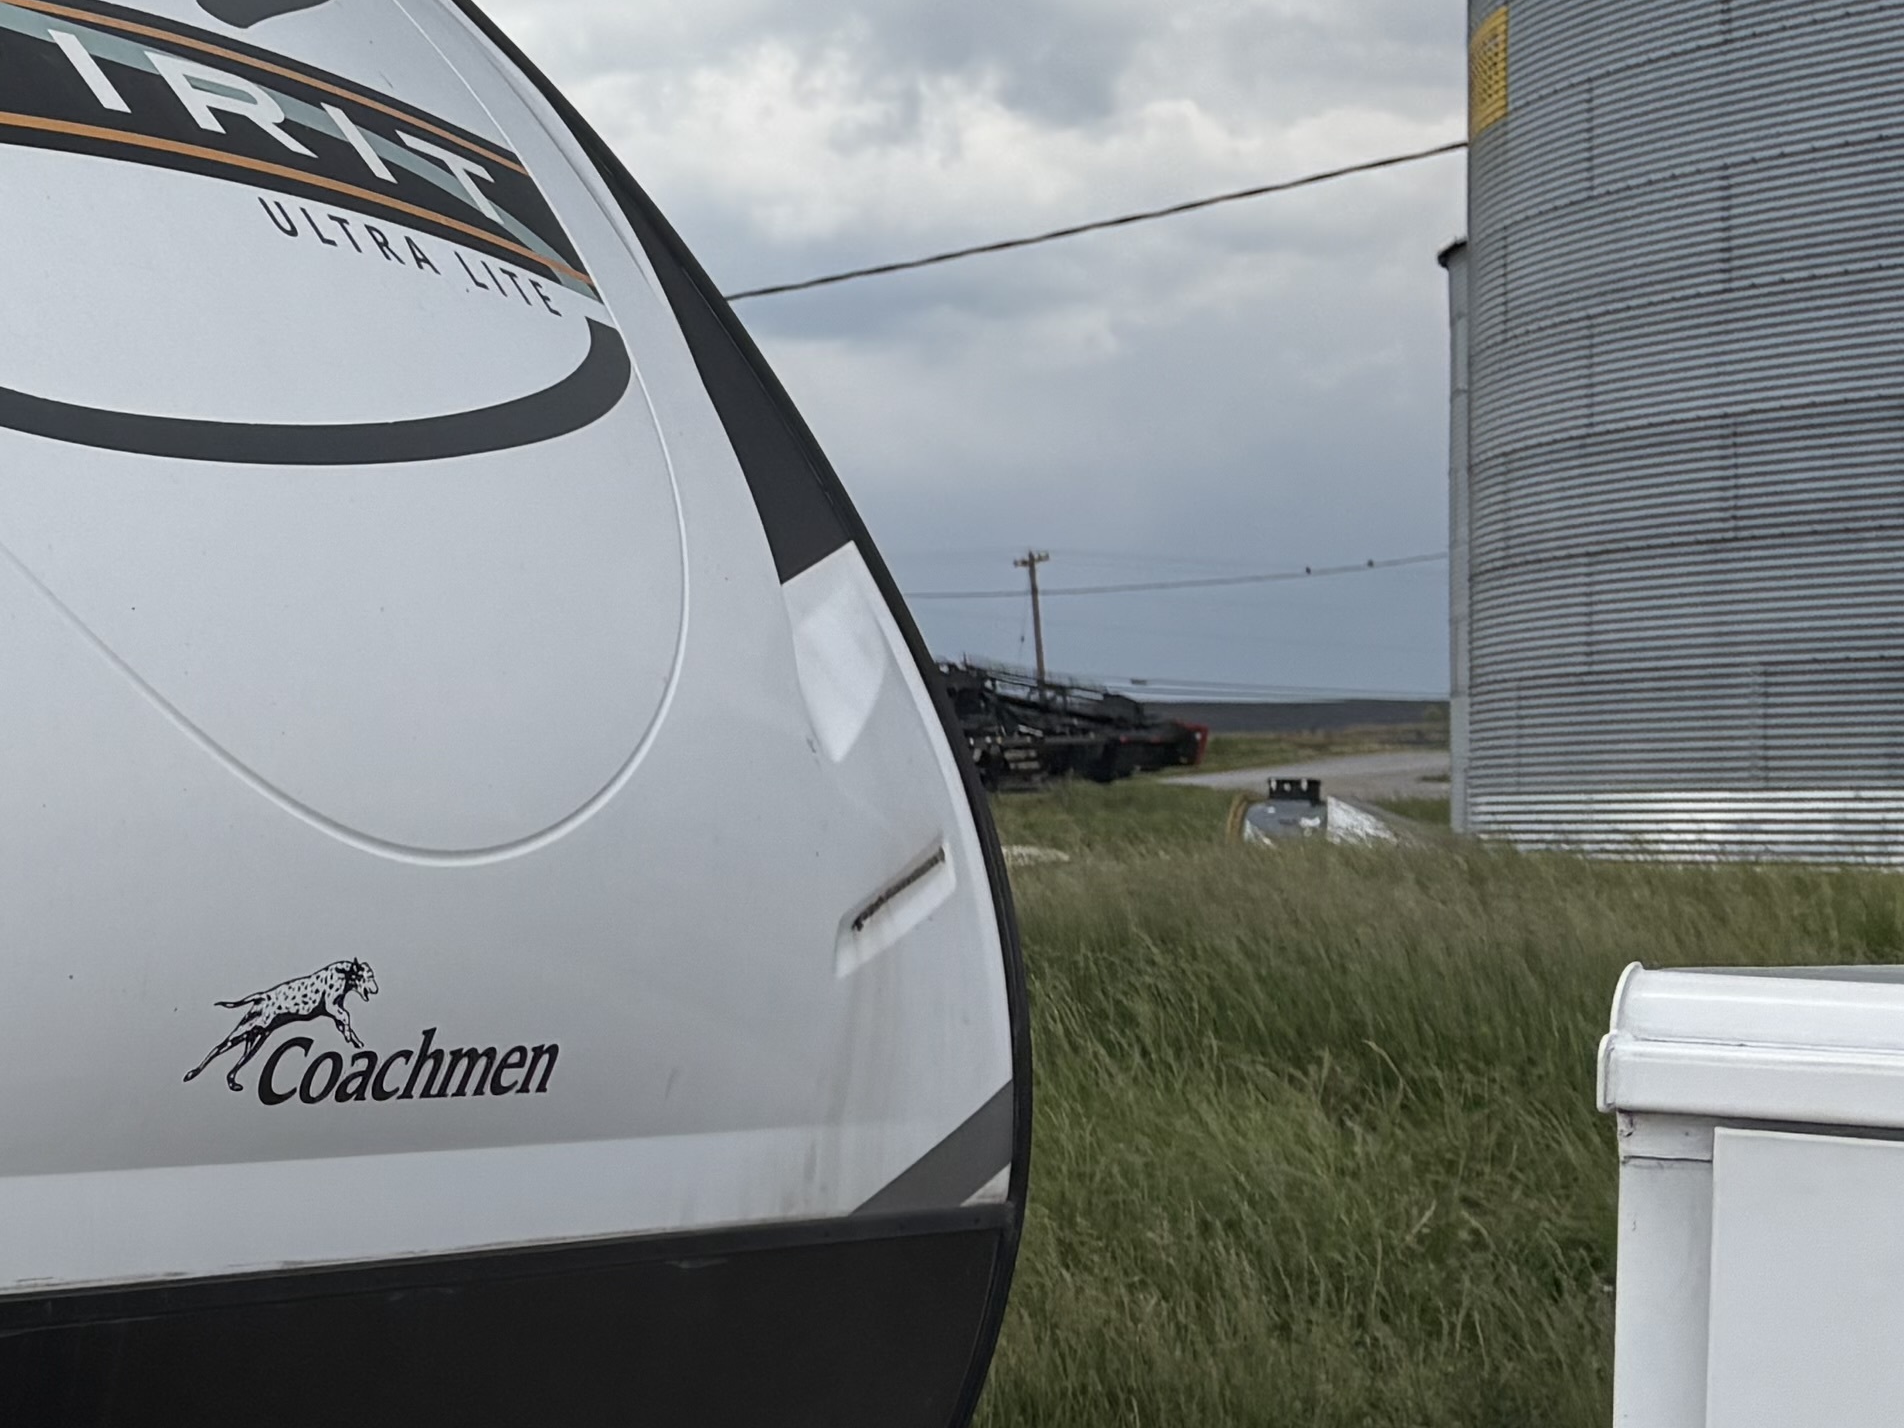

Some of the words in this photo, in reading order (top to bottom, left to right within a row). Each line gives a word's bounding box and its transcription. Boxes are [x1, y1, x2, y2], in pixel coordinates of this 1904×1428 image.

[257, 196, 442, 276] ULTRA
[453, 250, 563, 318] LITE
[256, 1026, 561, 1107] Coachmen
